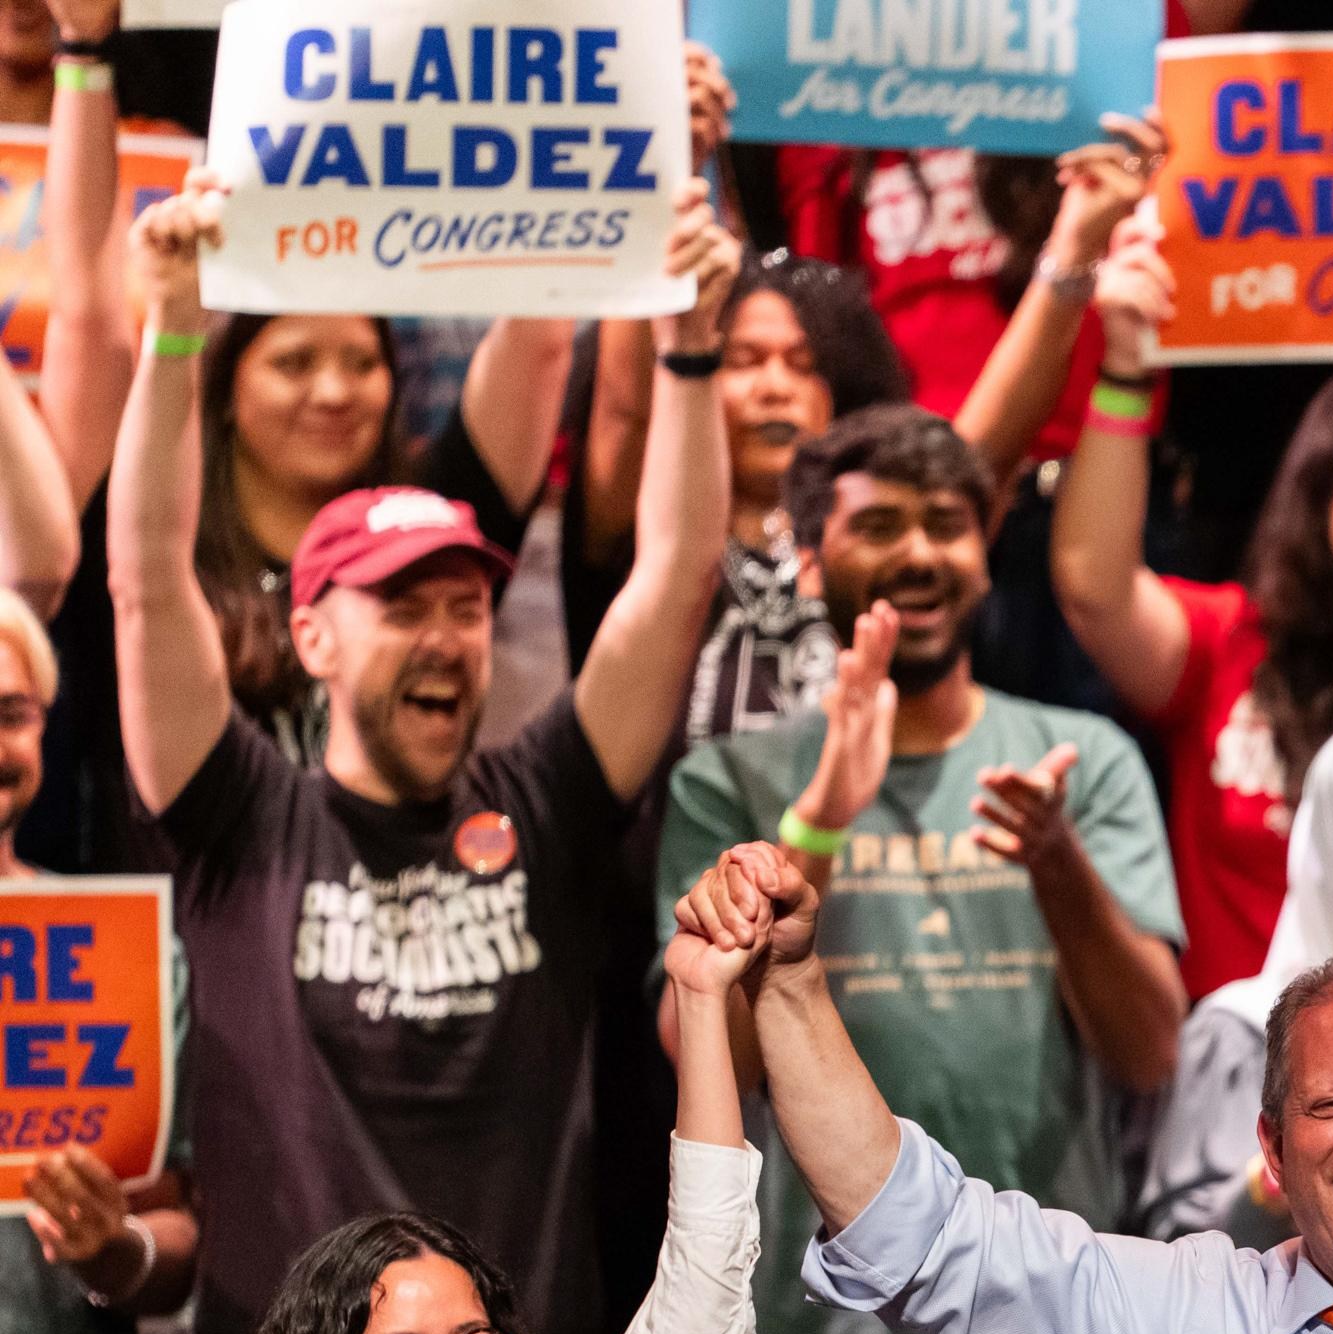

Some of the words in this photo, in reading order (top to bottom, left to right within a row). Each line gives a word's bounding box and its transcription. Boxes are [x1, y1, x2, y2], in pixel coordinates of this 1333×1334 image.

[284, 26, 619, 104] CLAIRE
[787, 0, 1077, 75] LANDER
[779, 66, 863, 119] for
[248, 124, 658, 191] VALDEZ
[276, 216, 359, 263] FOR
[1210, 262, 1297, 317] FOR
